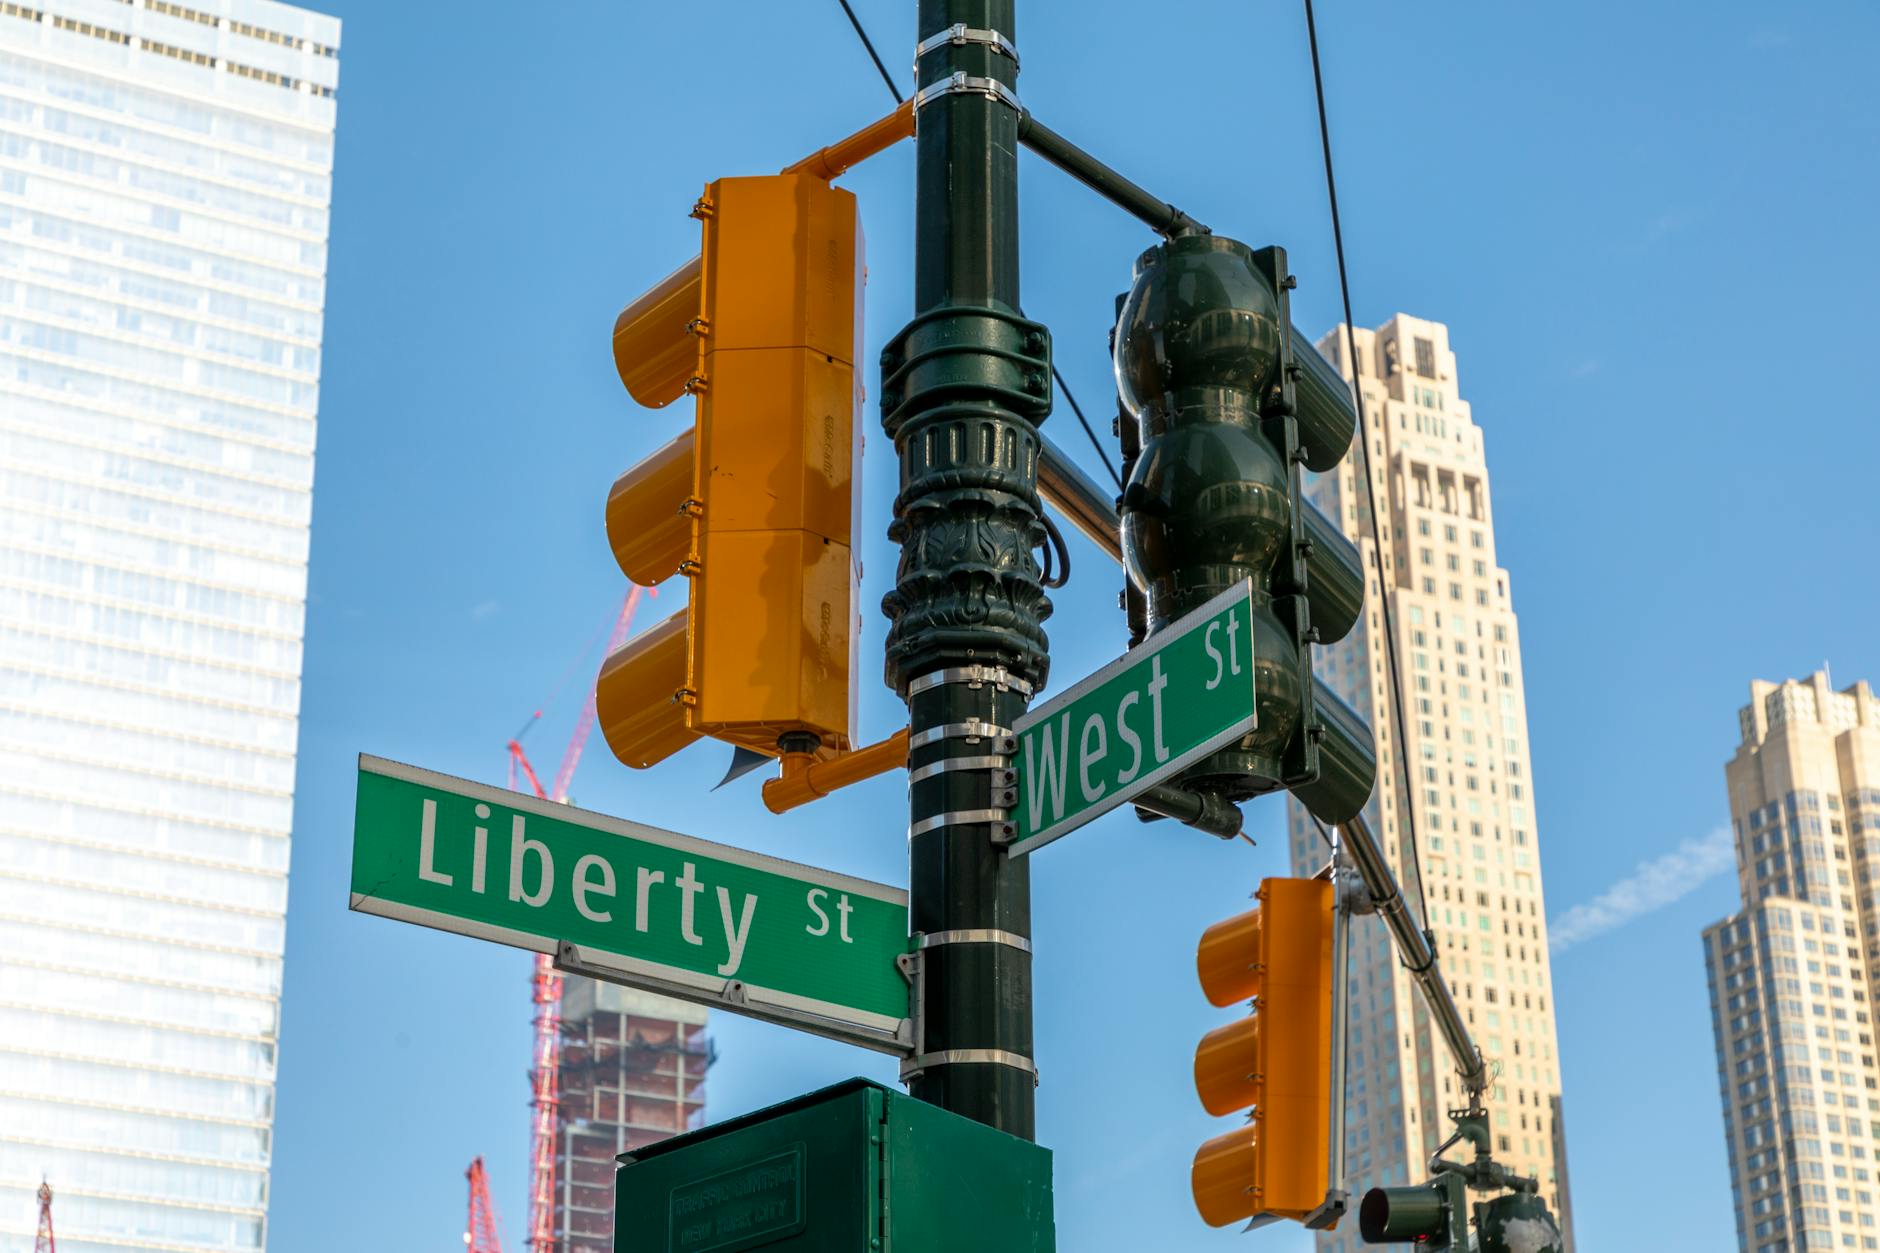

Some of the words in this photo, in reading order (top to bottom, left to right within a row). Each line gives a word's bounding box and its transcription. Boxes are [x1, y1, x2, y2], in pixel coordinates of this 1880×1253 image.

[1024, 653, 1169, 832] West
[1205, 609, 1240, 690] St
[419, 799, 757, 976] Liberty
[806, 888, 854, 944] St
